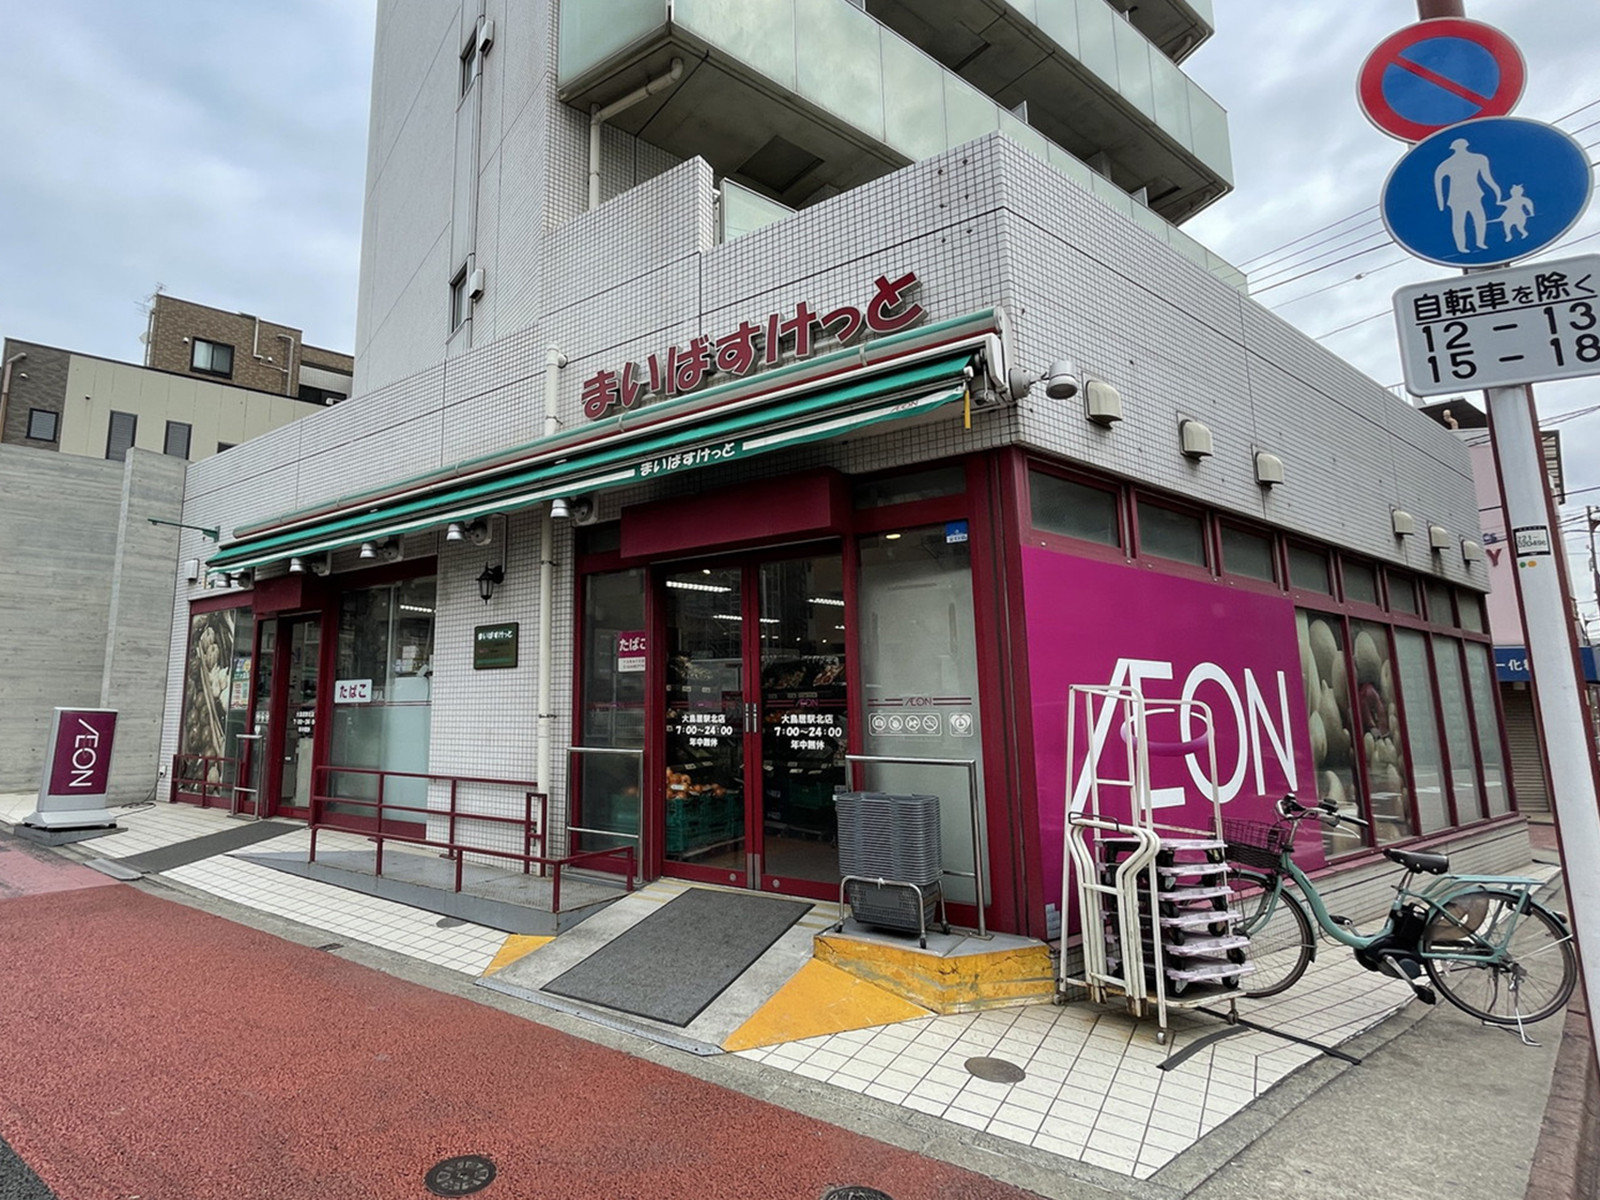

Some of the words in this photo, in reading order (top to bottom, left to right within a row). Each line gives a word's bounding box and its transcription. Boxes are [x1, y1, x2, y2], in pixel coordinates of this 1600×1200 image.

[1413, 271, 1595, 321] 自転車を除く
[580, 271, 924, 420] まいばすけっと
[639, 442, 736, 477] まいばすけっと
[340, 684, 367, 699] たばこ
[789, 739, 826, 751] 年中無休
